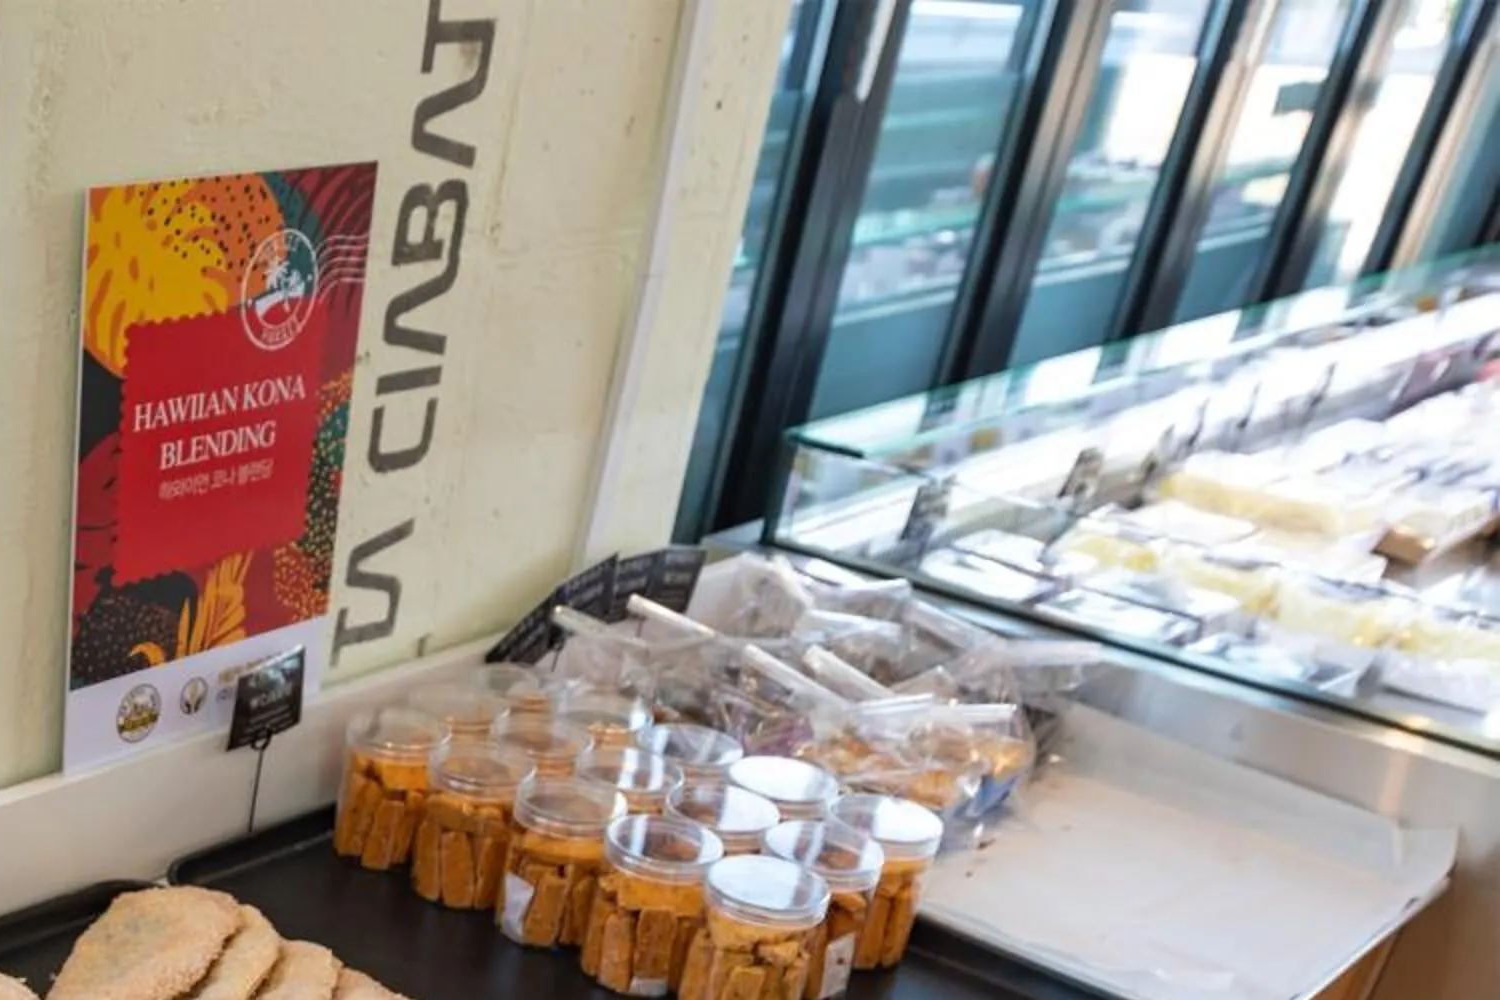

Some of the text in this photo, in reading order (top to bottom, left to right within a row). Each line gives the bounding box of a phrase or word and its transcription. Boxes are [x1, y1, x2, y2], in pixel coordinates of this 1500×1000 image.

[133, 374, 306, 432] HAWIIAN KONA
[160, 420, 276, 470] BLENDING
